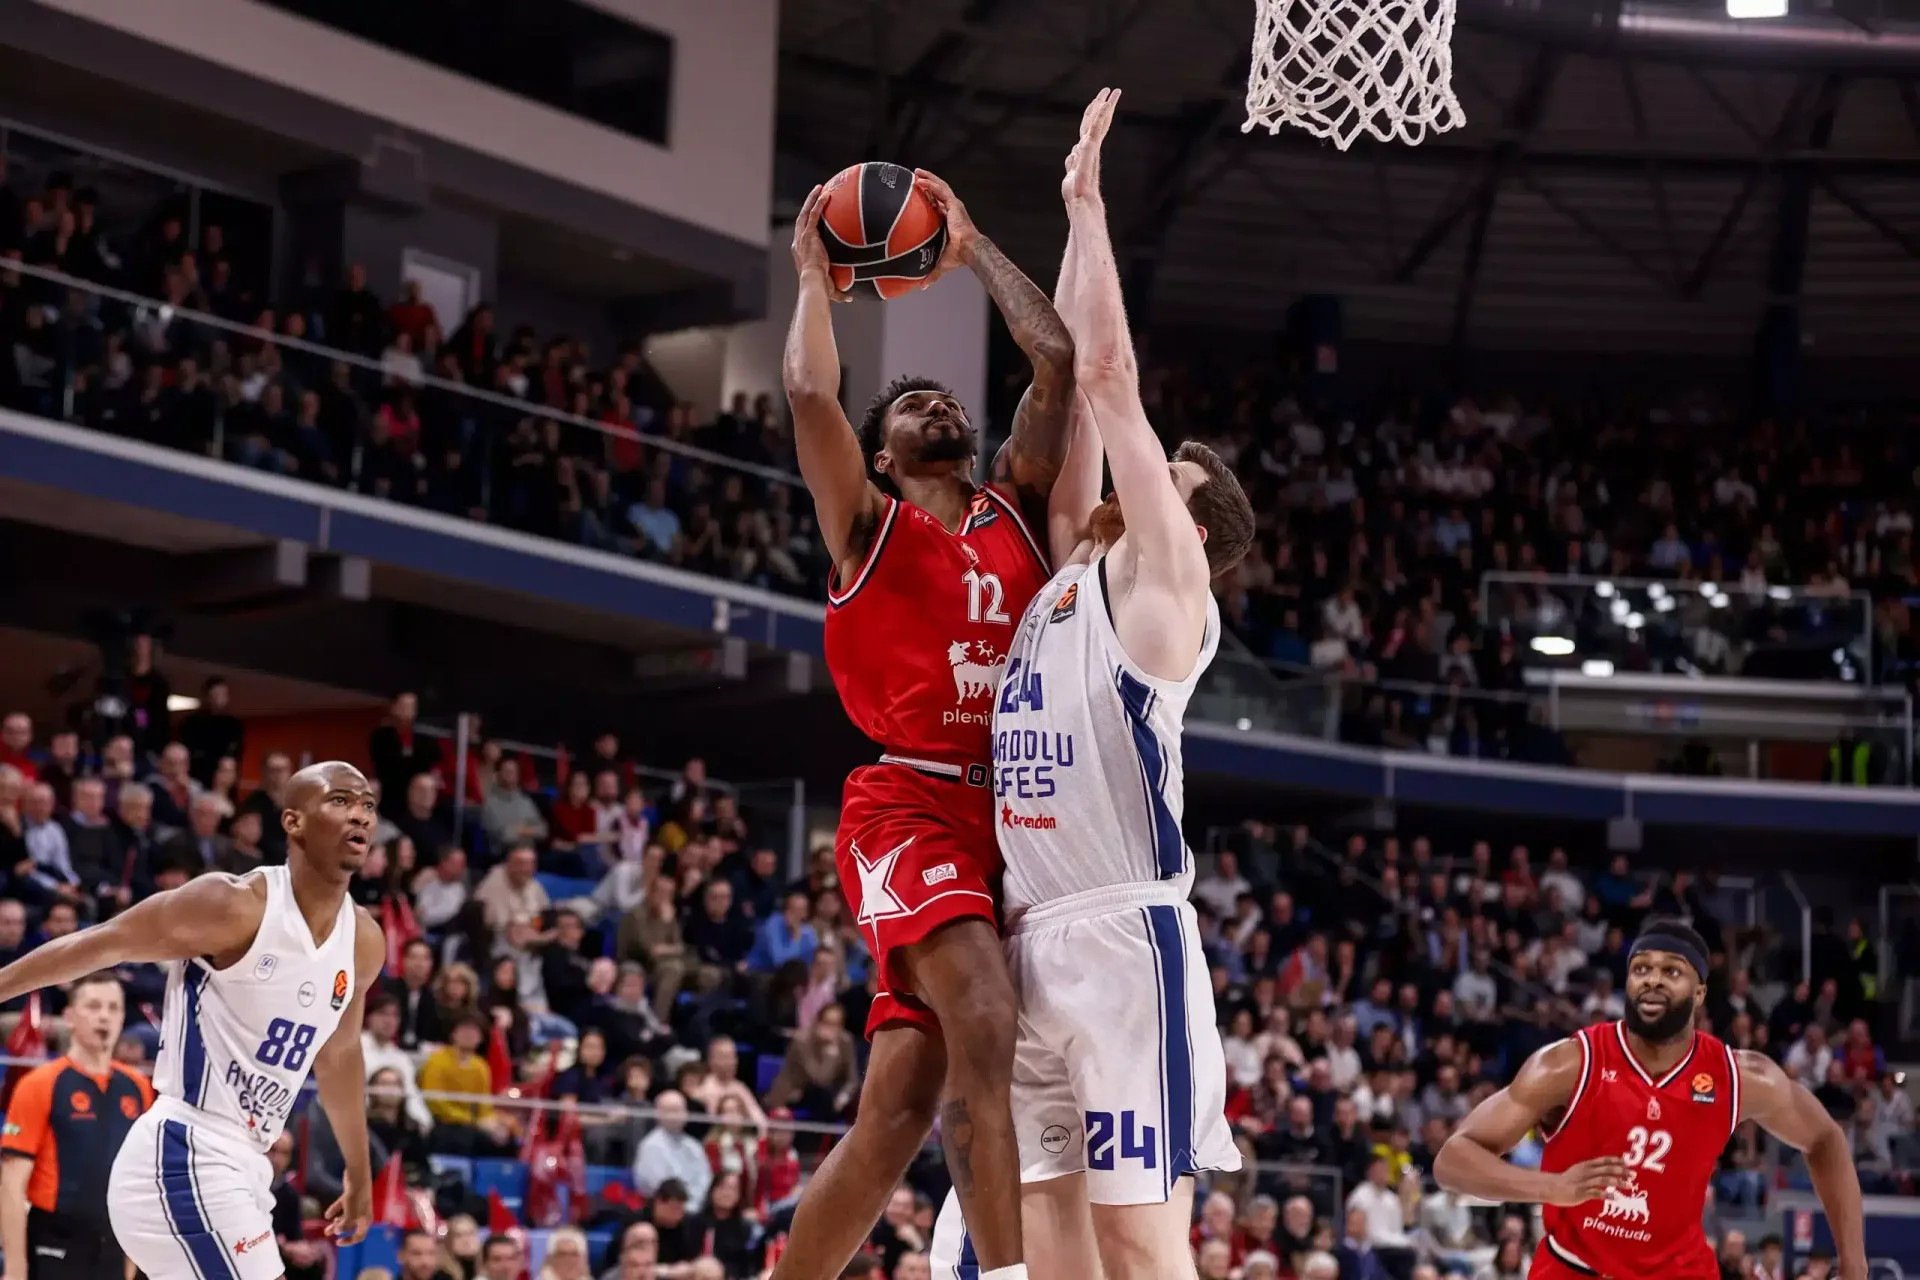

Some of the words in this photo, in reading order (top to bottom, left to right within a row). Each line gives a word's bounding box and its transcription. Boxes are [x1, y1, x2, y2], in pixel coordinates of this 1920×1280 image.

[962, 567, 1011, 625] 12
[998, 657, 1044, 713] 24
[924, 864, 950, 880] EA7
[255, 1017, 318, 1072] 88
[1043, 1135, 1069, 1144] GSA
[1085, 1110, 1157, 1171] 24
[1623, 1126, 1673, 1175] 32
[1583, 1216, 1653, 1242] plenitude
